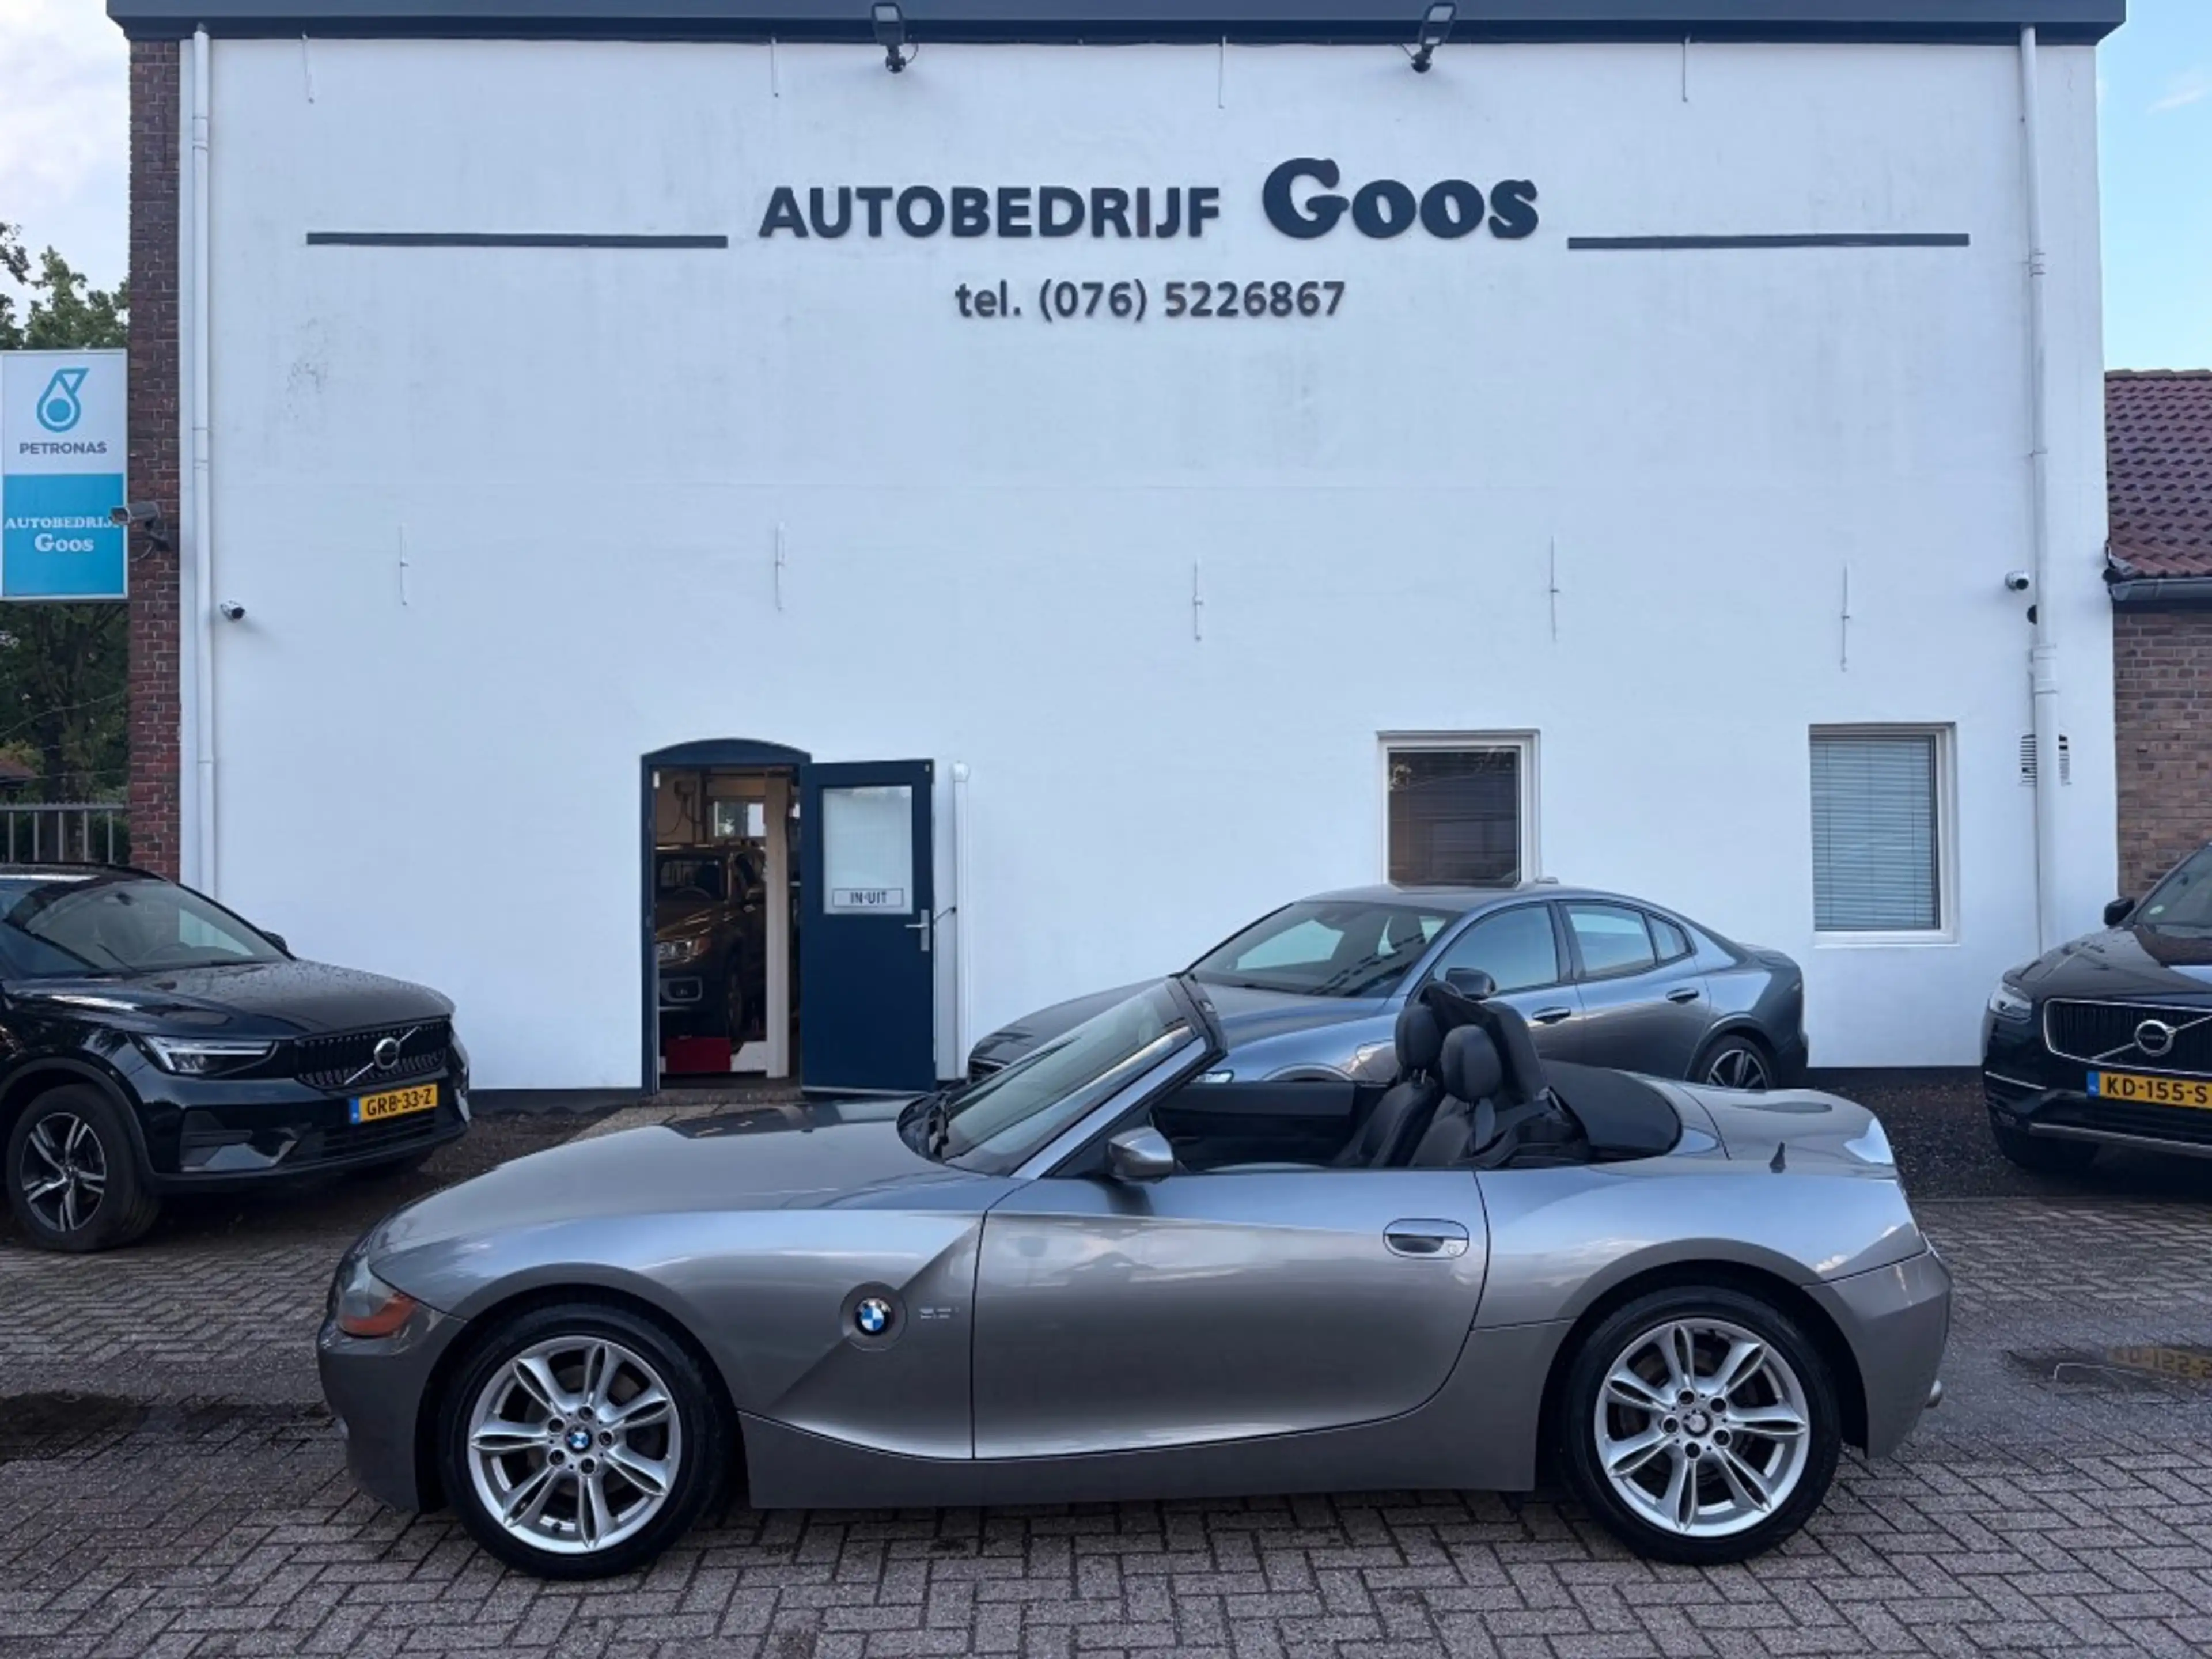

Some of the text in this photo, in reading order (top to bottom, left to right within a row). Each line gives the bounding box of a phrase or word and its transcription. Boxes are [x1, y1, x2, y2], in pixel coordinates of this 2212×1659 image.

[758, 157, 1539, 239] AUTOBEDRIJF Goos
[955, 279, 1345, 322] tel. (076) 5226867
[19, 441, 107, 454] PETRONAS
[5, 516, 120, 528] AUTOBEDRIJ
[35, 533, 94, 552] Goos
[367, 1088, 431, 1115] GRB-33-Z
[2106, 1076, 2208, 1104] KD-155-S
